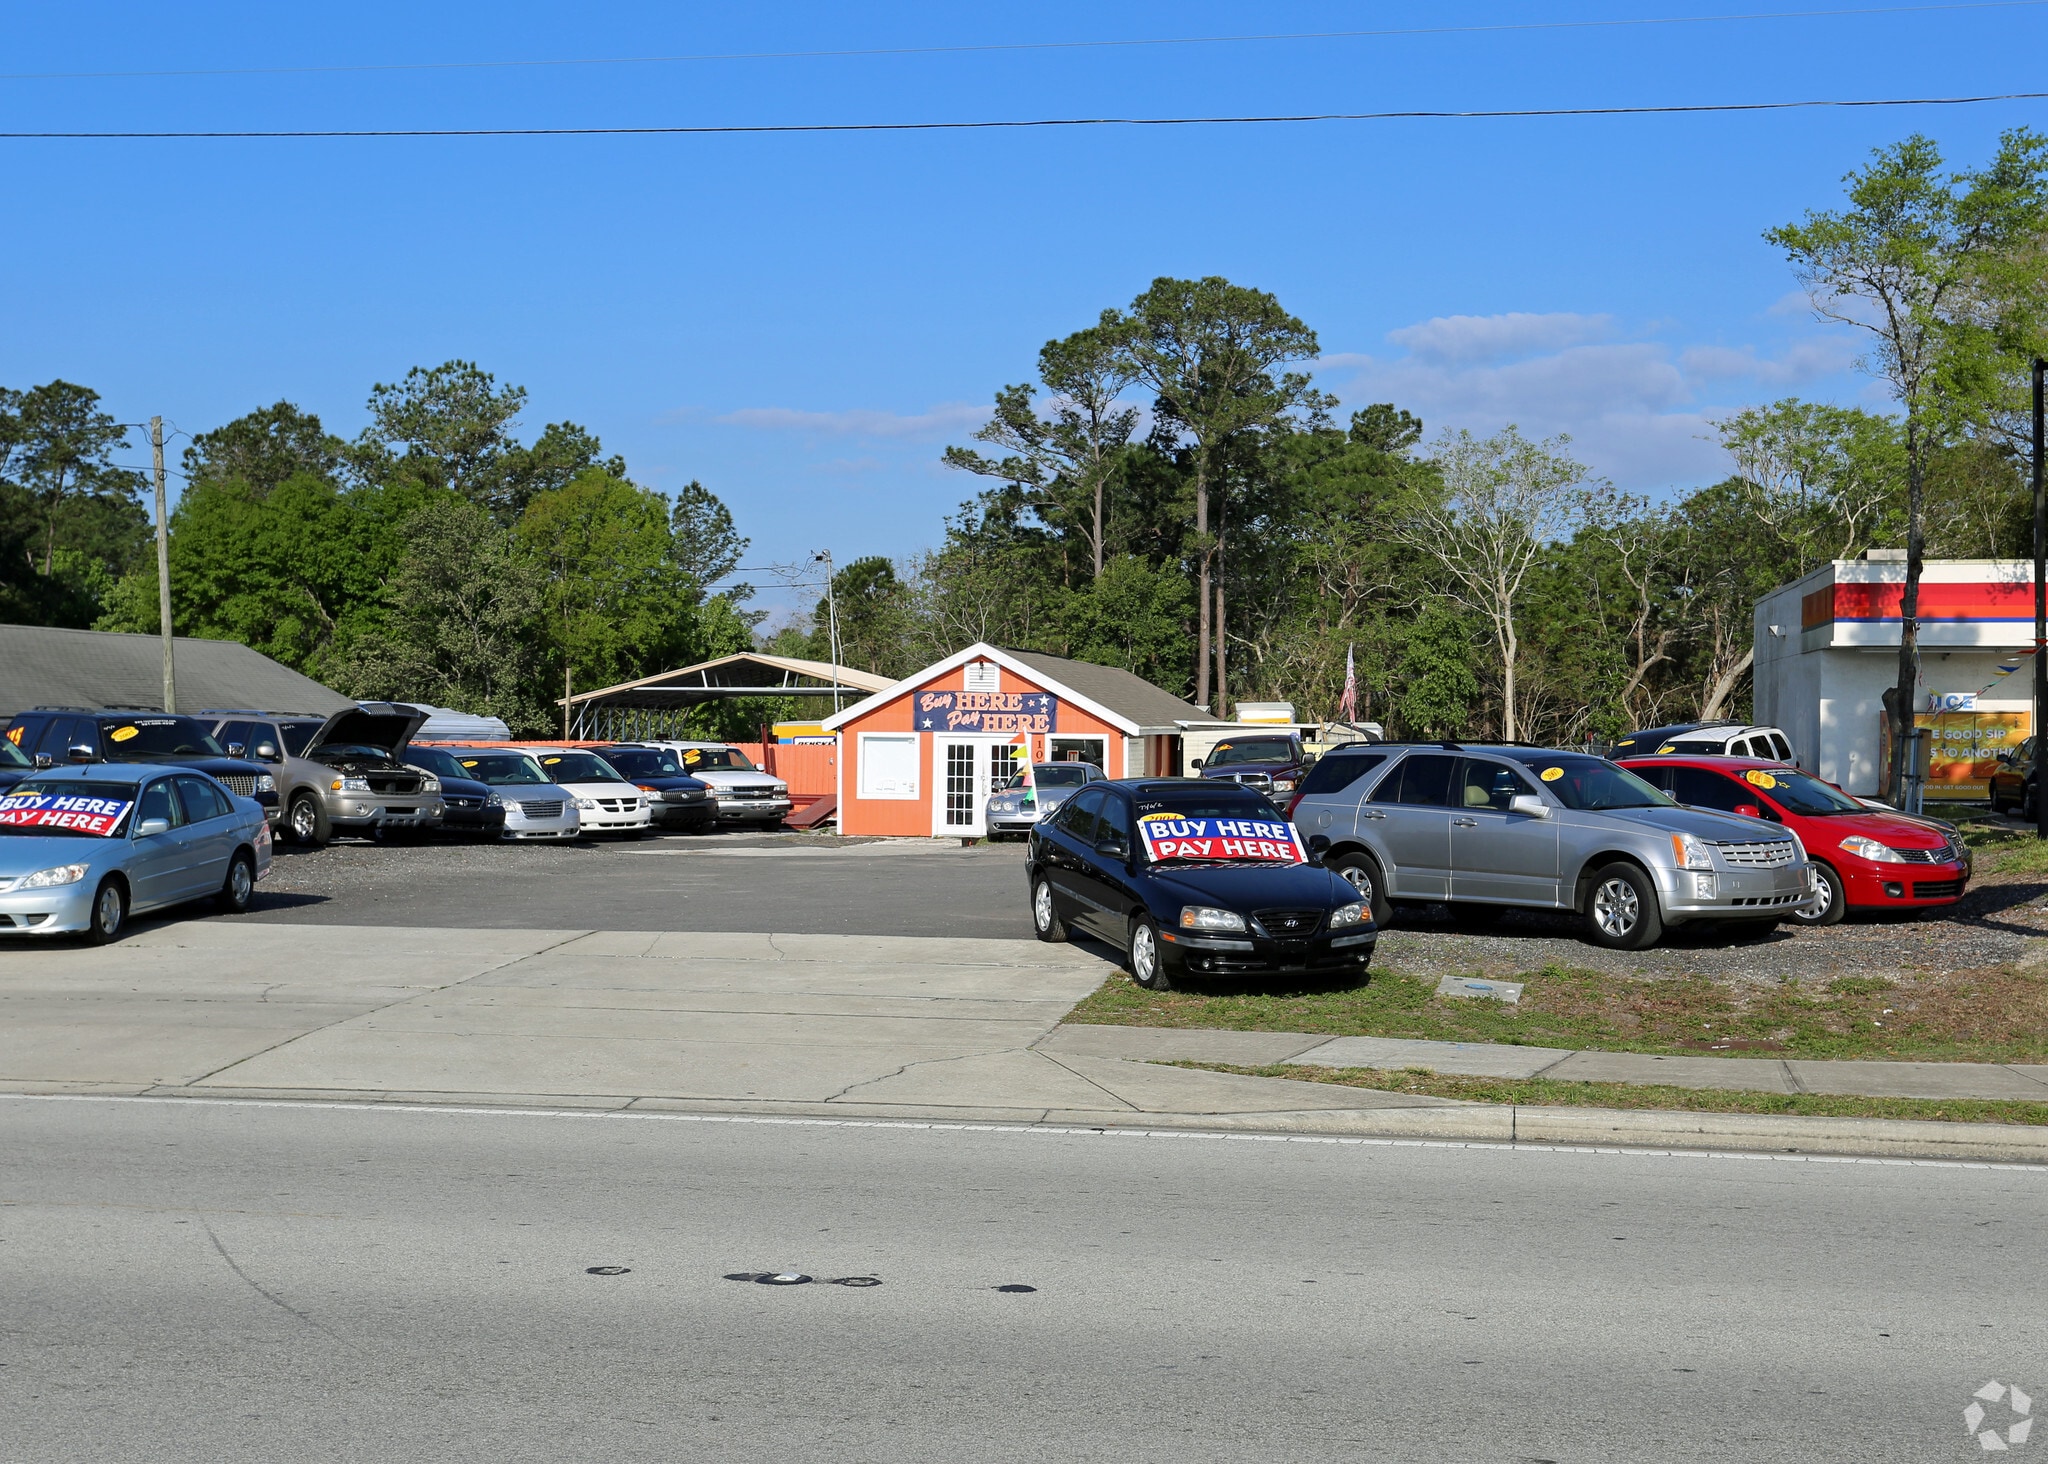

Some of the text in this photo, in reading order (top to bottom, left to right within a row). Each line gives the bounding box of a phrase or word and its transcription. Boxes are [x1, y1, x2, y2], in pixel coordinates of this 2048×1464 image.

[920, 692, 1023, 712] Buy HERE
[1936, 695, 1973, 709] ICE
[946, 710, 1050, 733] Pay HERE
[1943, 729, 1982, 740] GOOD
[1986, 729, 2006, 739] SIP
[1035, 740, 1044, 763] 10
[1940, 747, 1958, 758] TO
[0, 796, 120, 816] BUY HERE
[38, 811, 108, 832] HERE
[1150, 820, 1288, 840] BUY HERE
[1158, 839, 1294, 860] PAY HERE
